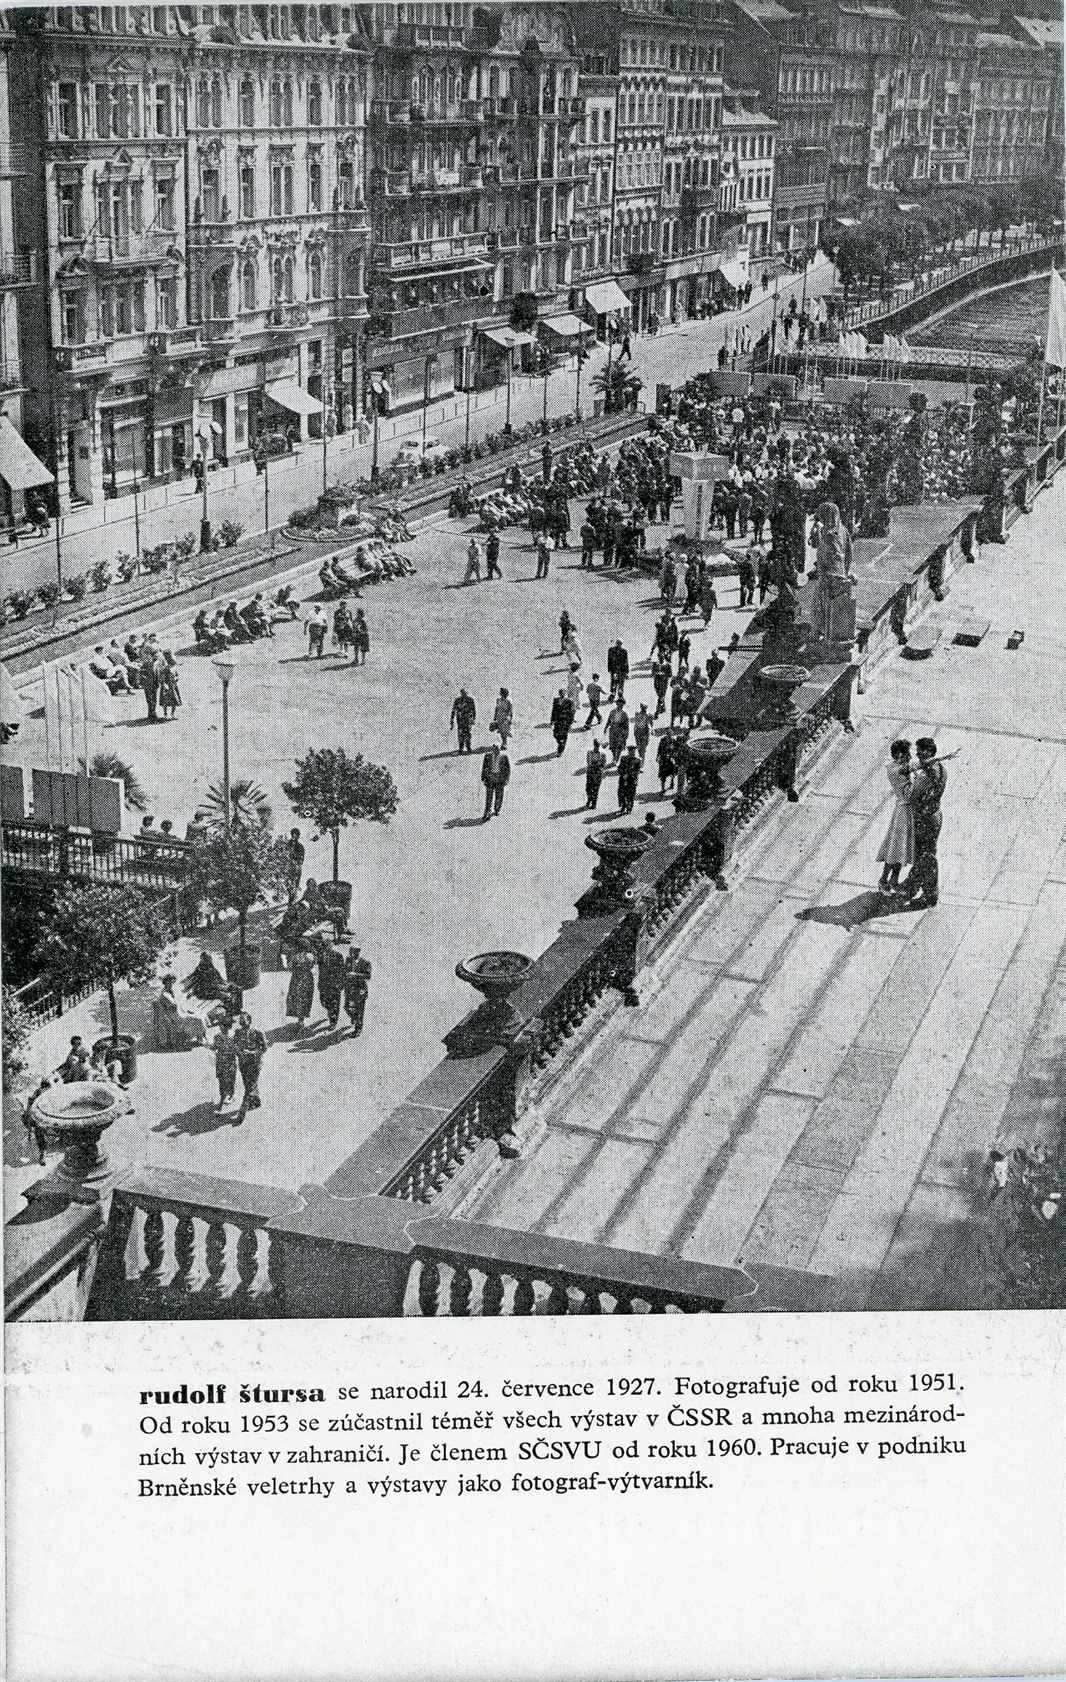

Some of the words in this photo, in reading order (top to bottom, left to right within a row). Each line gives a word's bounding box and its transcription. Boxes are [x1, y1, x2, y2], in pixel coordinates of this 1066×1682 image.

[139, 1383, 227, 1405] rudolf
[239, 1383, 327, 1404] štursa
[338, 1386, 360, 1401] se
[370, 1380, 448, 1400] narodil
[457, 1380, 489, 1399] 24.
[501, 1379, 594, 1398] července
[607, 1377, 662, 1396] 1927.
[674, 1375, 800, 1399] Fotografuje
[810, 1374, 838, 1394] od
[848, 1374, 899, 1393] roku
[910, 1372, 965, 1392] 1951.
[139, 1415, 173, 1435] Od
[181, 1415, 231, 1435] roku
[240, 1414, 289, 1433] 1953
[298, 1418, 320, 1432] se
[328, 1412, 424, 1432] zúčastnil
[431, 1410, 494, 1430] téměř
[502, 1409, 563, 1429] všech
[570, 1409, 638, 1432] výstav
[646, 1414, 660, 1427] v
[667, 1404, 733, 1427] ČSSR
[741, 1412, 753, 1425] a
[761, 1405, 835, 1425] mnoha
[843, 1403, 966, 1424] mezinárod-
[138, 1446, 187, 1466] ních
[194, 1446, 263, 1469] výstav
[268, 1451, 281, 1464] v
[286, 1444, 390, 1464] zahraničí.
[398, 1443, 421, 1466] Je
[430, 1442, 508, 1462] členem
[518, 1437, 602, 1461] SČSVU
[612, 1439, 640, 1459] od
[647, 1439, 698, 1459] roku
[707, 1437, 762, 1457] 1960.
[770, 1436, 849, 1459] Pracuje
[856, 1441, 870, 1455] v
[877, 1435, 967, 1460] podniku
[137, 1477, 237, 1497] Brněnské
[246, 1476, 335, 1499] veletrhy
[345, 1480, 358, 1494] a
[367, 1475, 448, 1498] výstavy
[457, 1473, 502, 1497] jako
[511, 1470, 714, 1495] fotograf-výtvarník.
